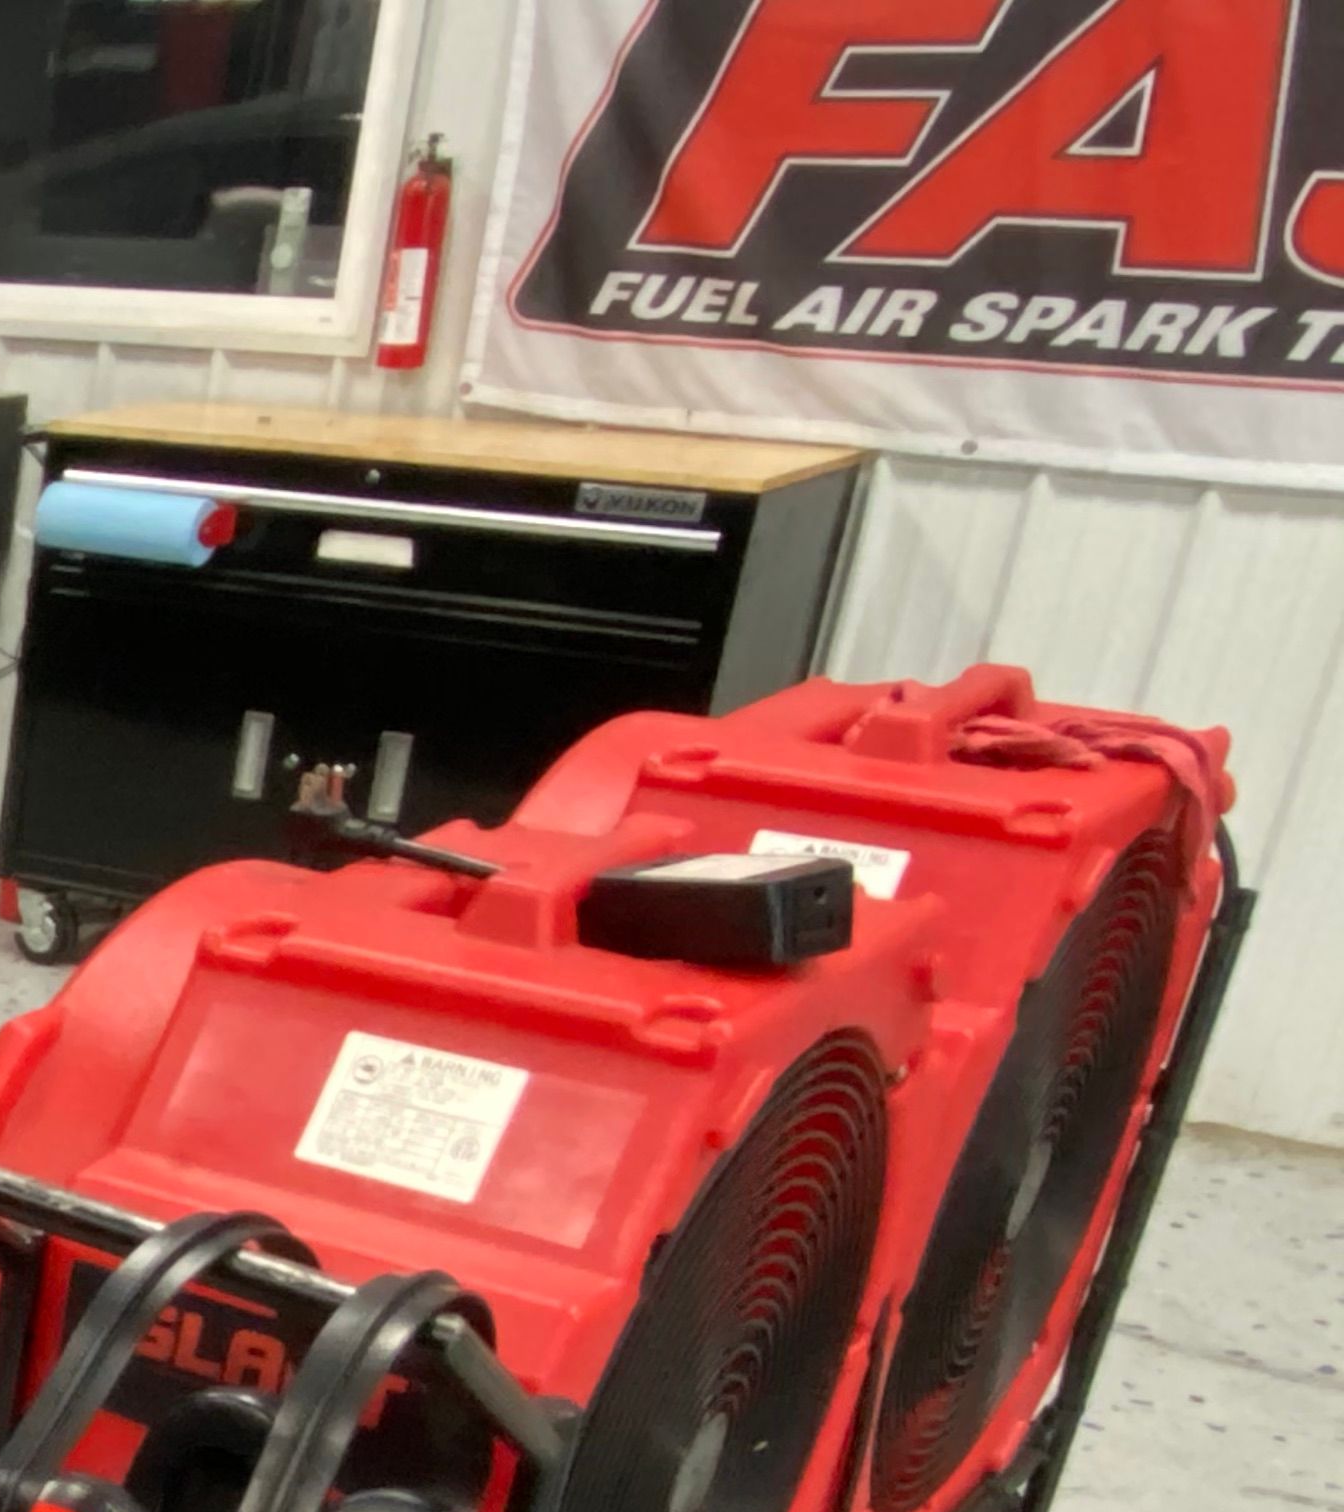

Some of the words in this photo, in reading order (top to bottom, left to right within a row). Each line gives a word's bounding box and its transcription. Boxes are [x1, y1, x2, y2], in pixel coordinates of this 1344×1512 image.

[589, 271, 760, 325] FUEL
[772, 285, 938, 337] AIR
[948, 292, 1278, 358] SPARK
[1285, 309, 1344, 364] T
[608, 494, 697, 515] YUKON
